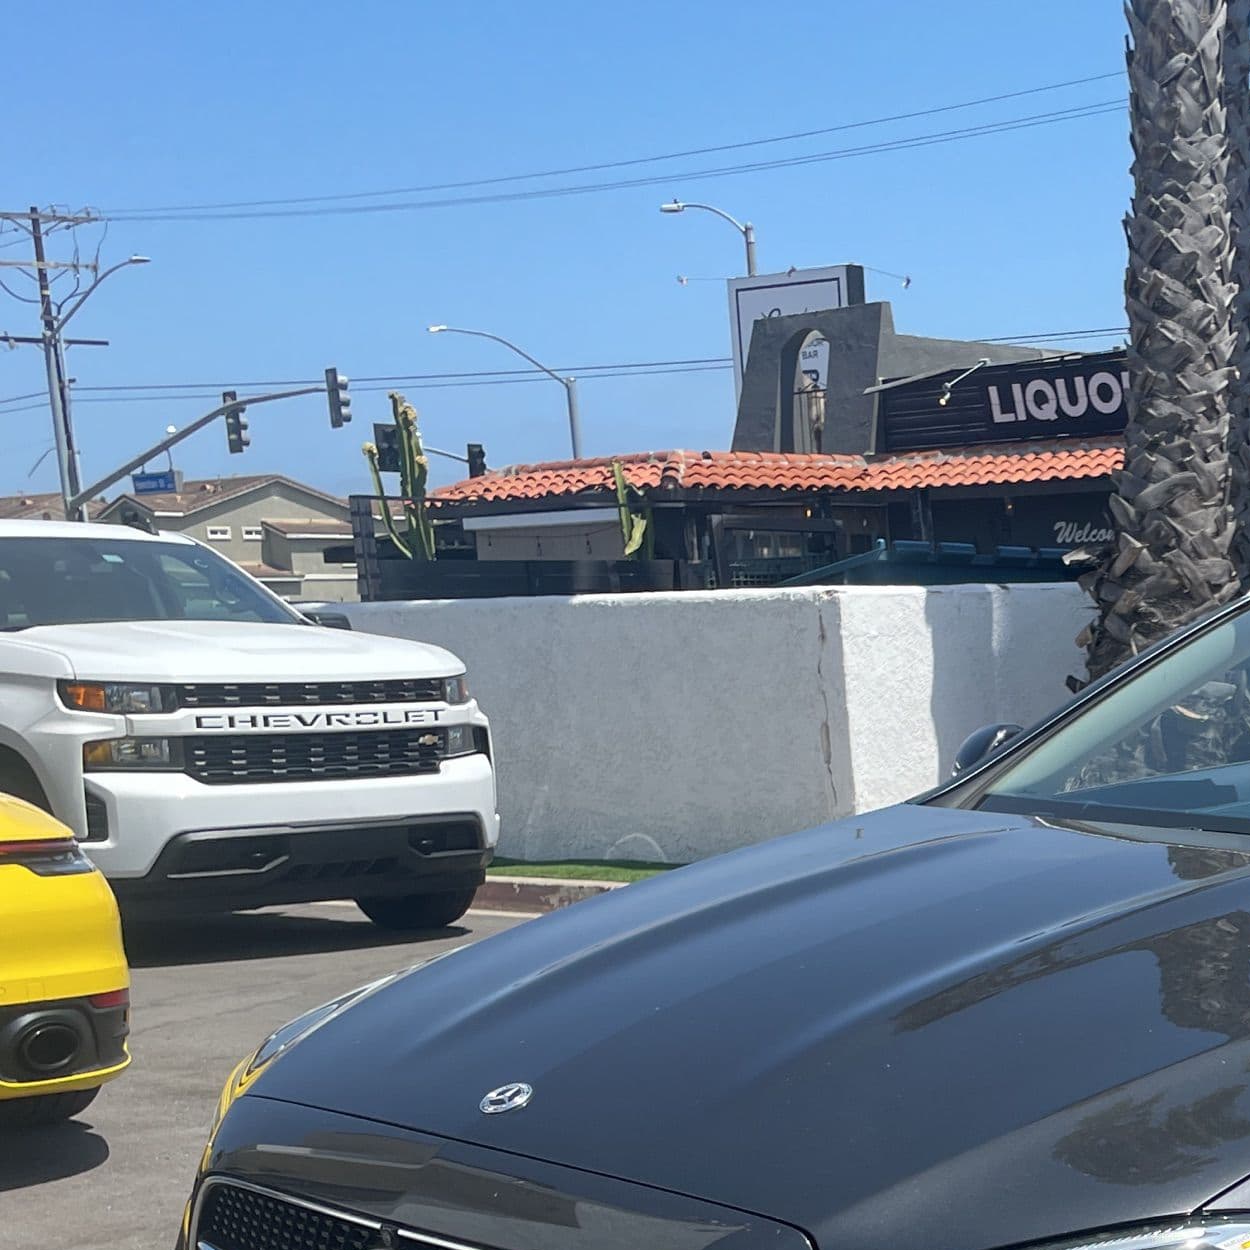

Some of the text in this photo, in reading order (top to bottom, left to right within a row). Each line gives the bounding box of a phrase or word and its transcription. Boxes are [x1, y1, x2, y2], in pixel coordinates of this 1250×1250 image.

[801, 349, 819, 361] BAR
[988, 371, 1130, 424] LIQUO
[195, 709, 446, 729] CHEVROLET
